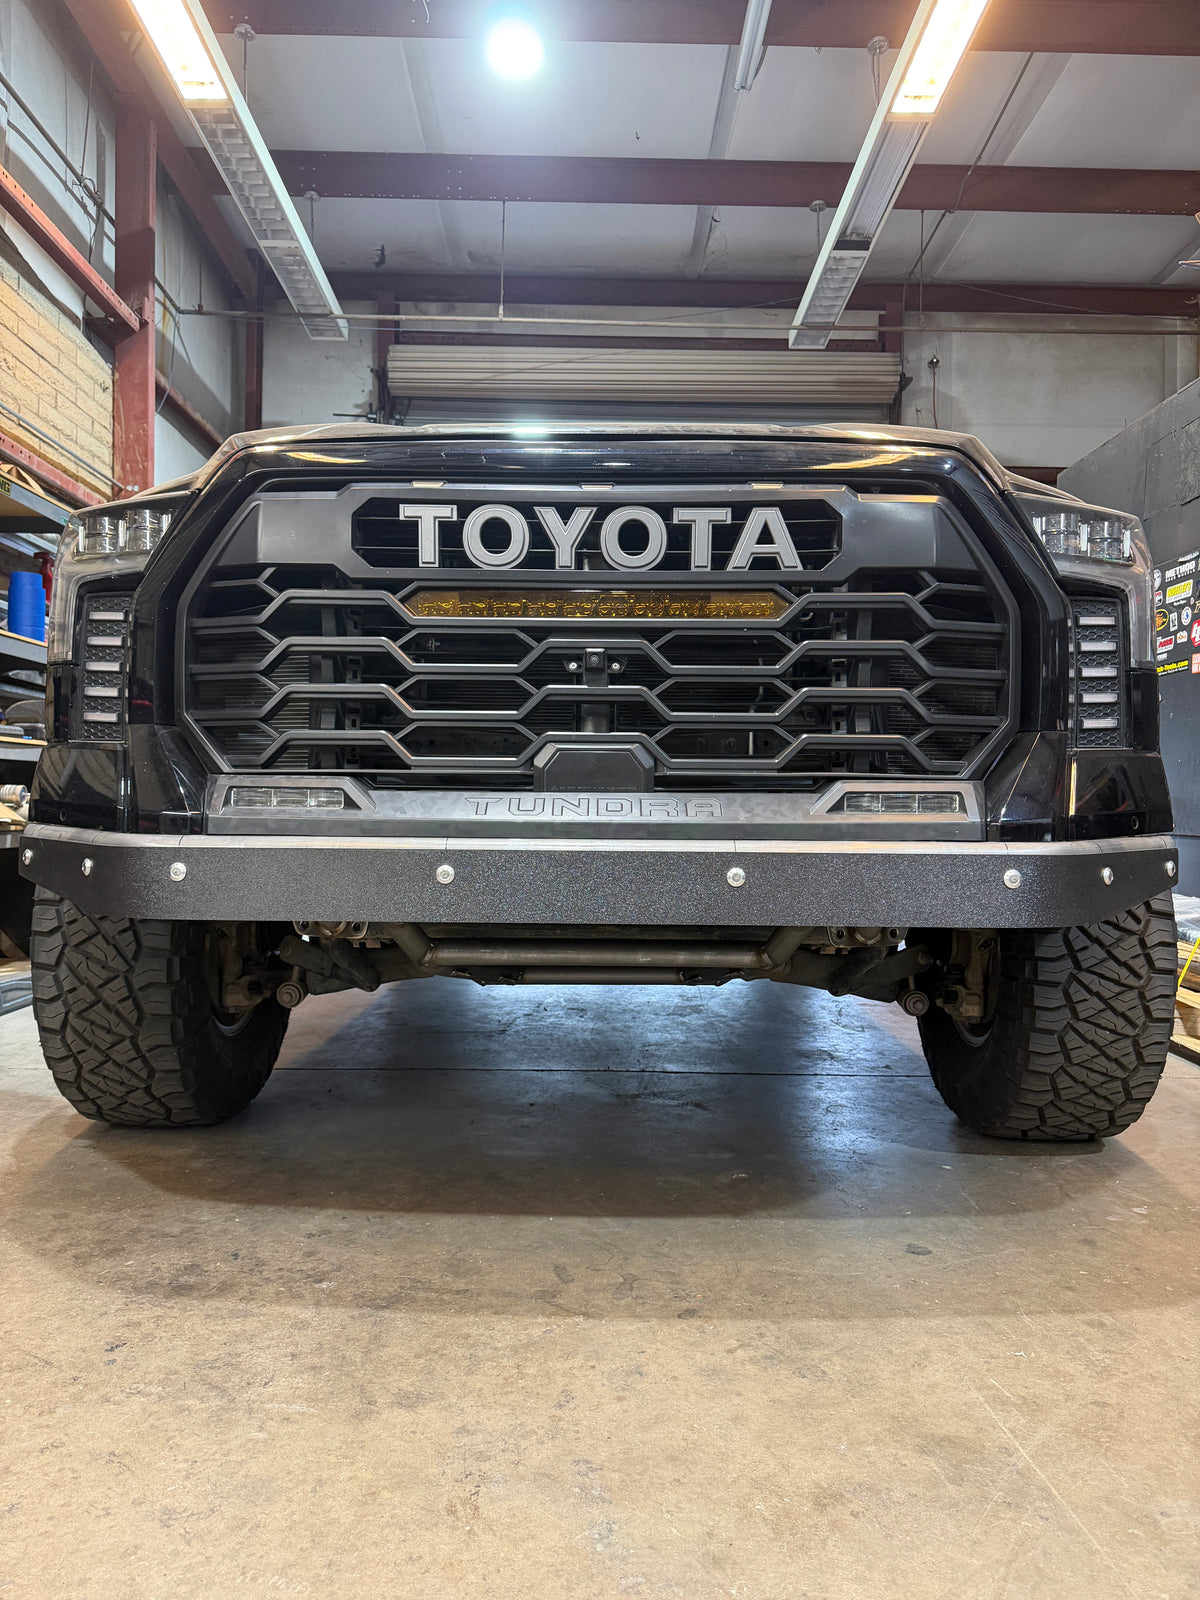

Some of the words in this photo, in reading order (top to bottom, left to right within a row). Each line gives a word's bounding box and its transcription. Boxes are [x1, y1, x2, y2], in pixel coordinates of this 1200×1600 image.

[399, 503, 804, 572] TOYOTA
[1165, 561, 1195, 579] METHOD
[464, 797, 724, 818] TUNDRA
